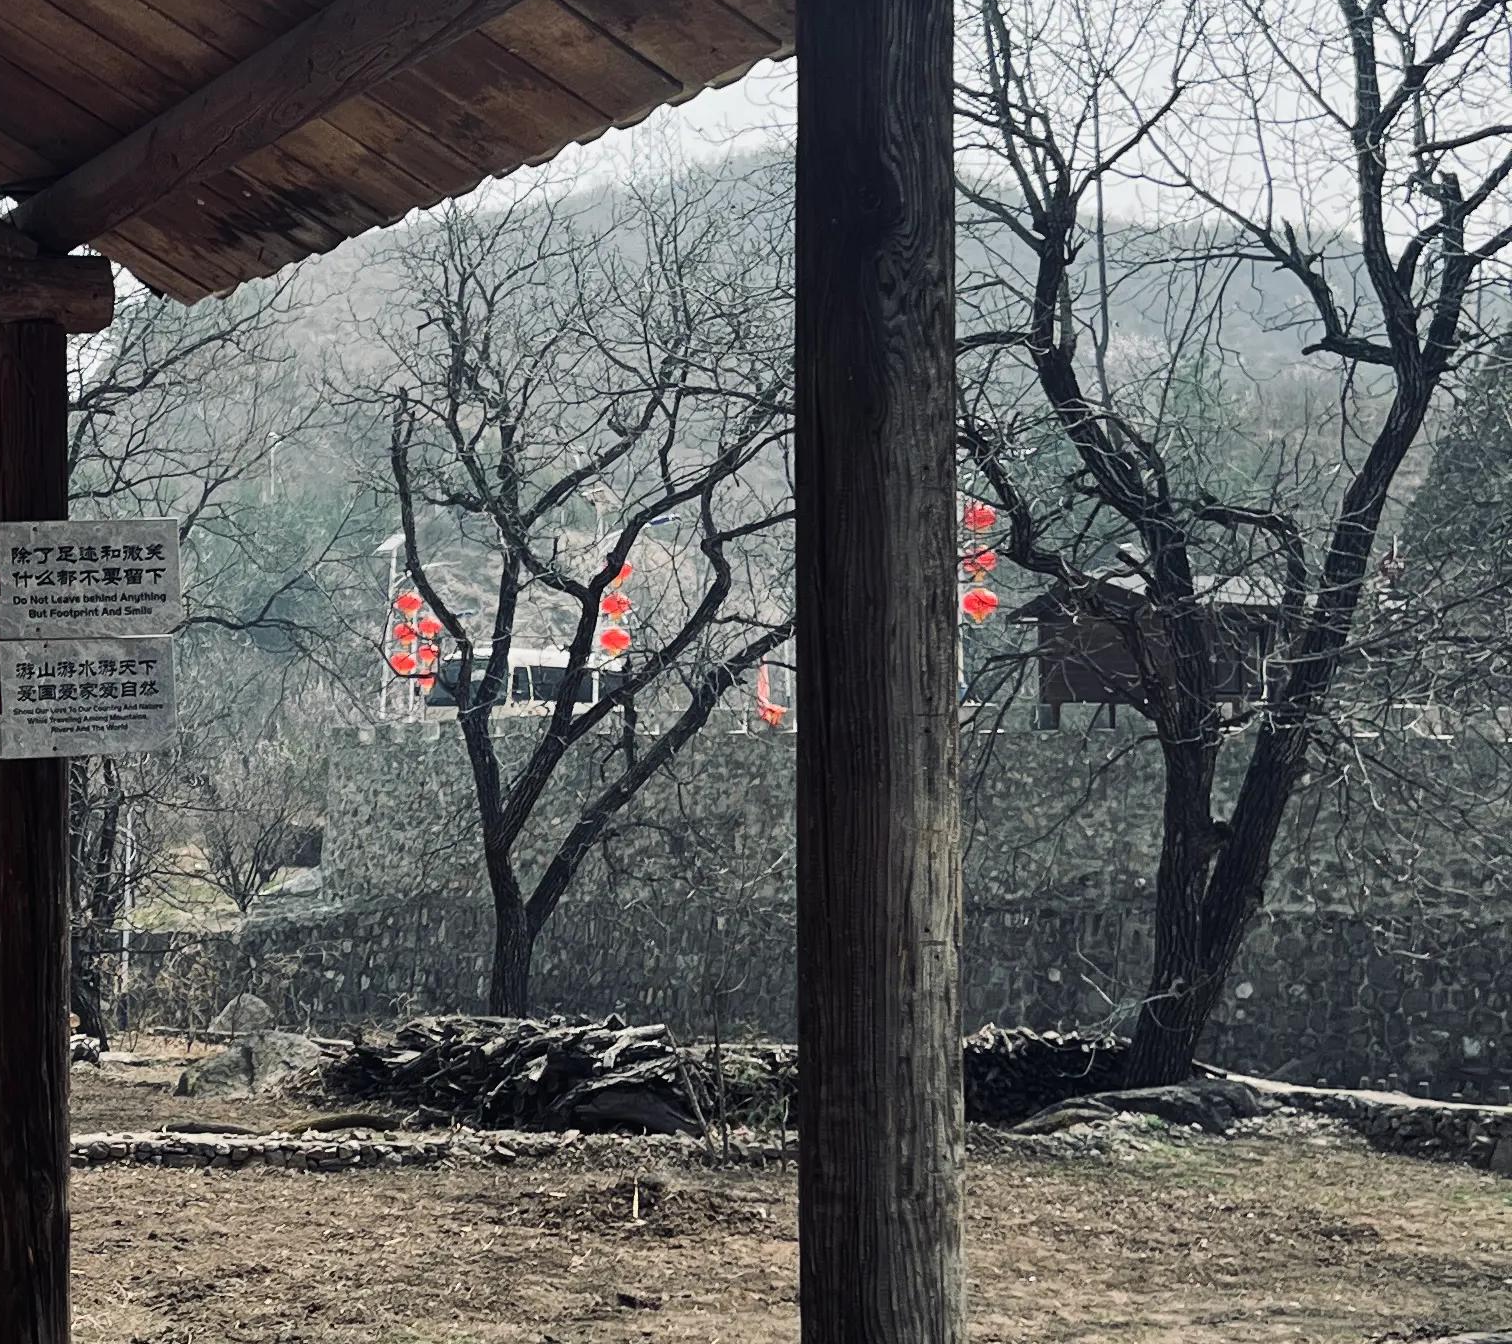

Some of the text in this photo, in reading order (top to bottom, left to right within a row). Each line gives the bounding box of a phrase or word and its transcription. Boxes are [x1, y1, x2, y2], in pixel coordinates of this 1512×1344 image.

[11, 544, 166, 565] 除了足迹和微笑
[12, 567, 167, 588] 什么都不要留下
[13, 592, 167, 605] Do Not Leave behind Anything
[28, 606, 152, 619] But Footprint And Smile
[15, 659, 158, 680] 游山游水游天下
[17, 680, 160, 702] 爱国爱家爱自然
